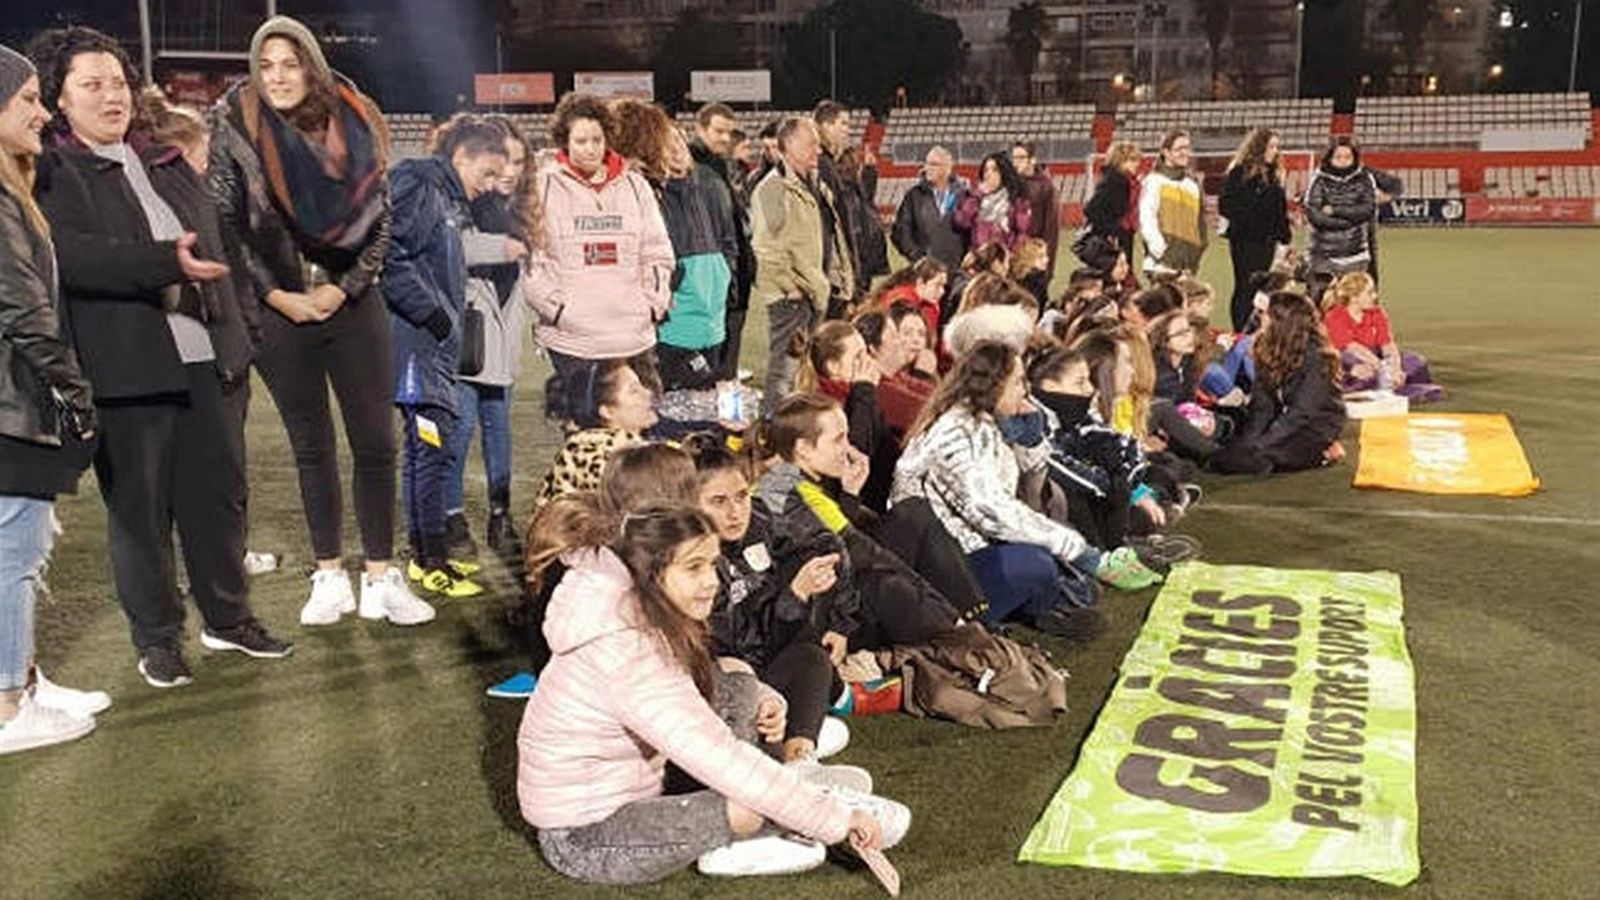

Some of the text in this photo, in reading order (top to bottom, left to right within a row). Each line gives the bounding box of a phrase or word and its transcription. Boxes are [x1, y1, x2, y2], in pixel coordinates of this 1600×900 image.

[1292, 596, 1369, 831] PEL VOSTRE SUPORT
